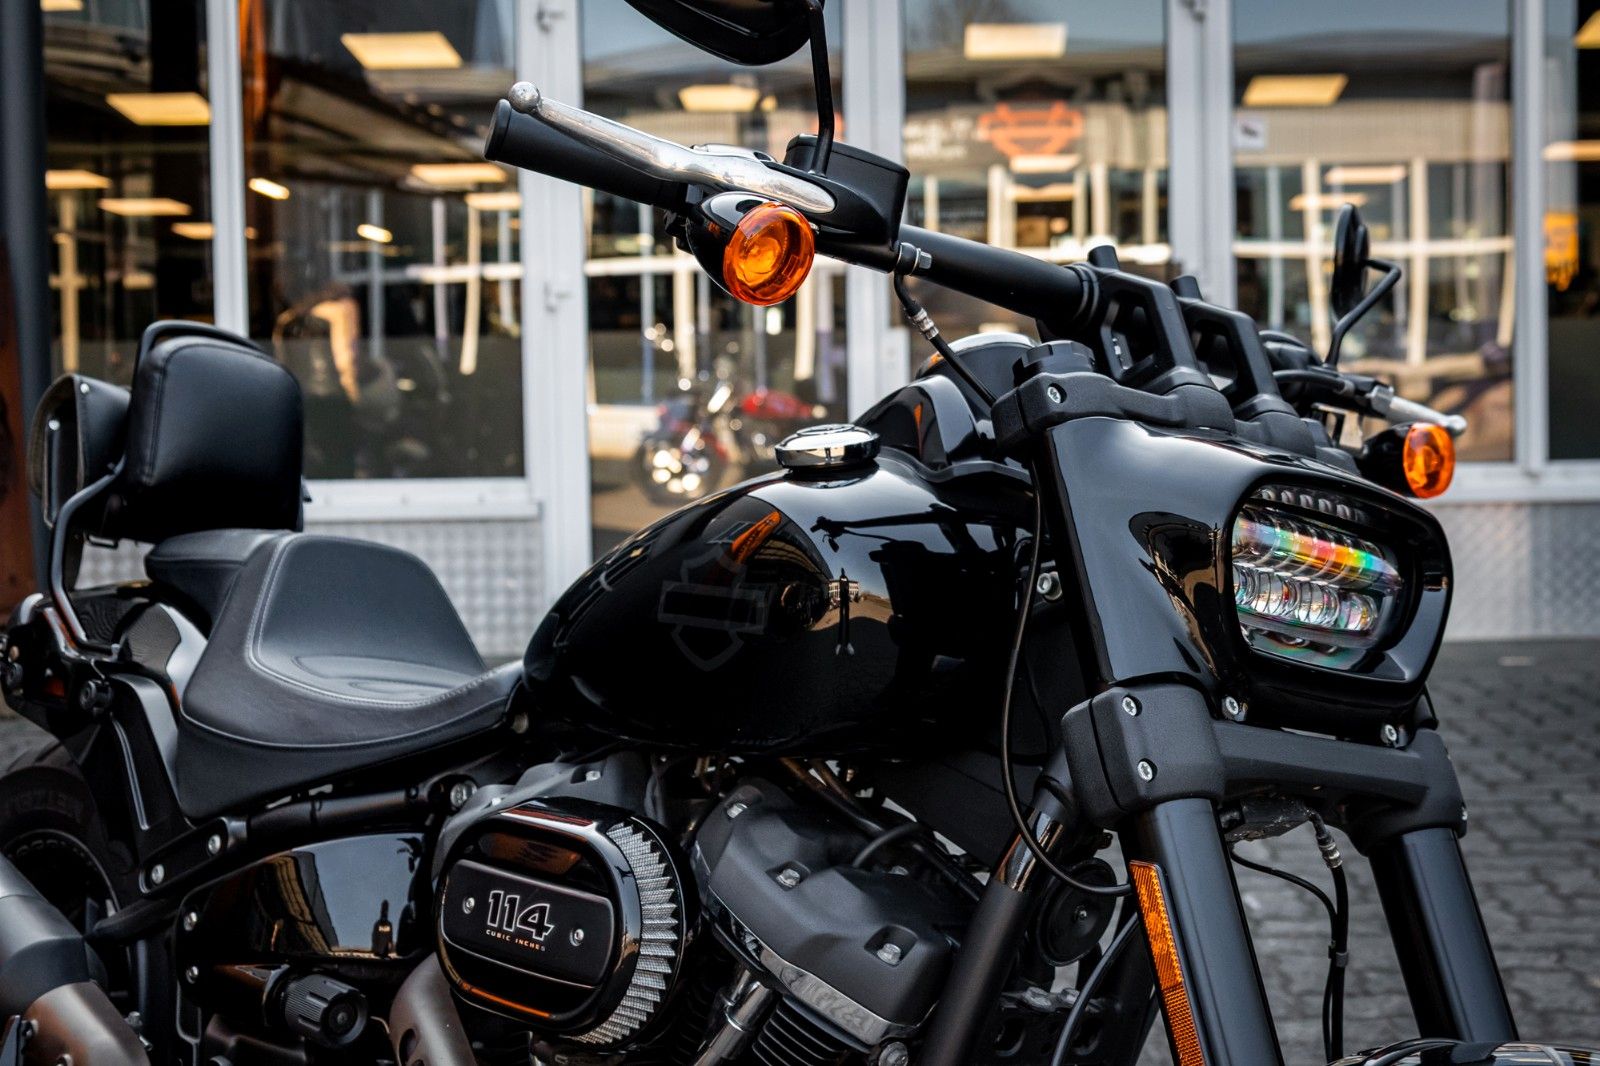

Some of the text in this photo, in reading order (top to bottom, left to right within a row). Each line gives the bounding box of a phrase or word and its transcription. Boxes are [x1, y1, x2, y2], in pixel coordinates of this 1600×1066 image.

[487, 890, 555, 941] 114
[486, 929, 546, 952] CUBIC INCHES
